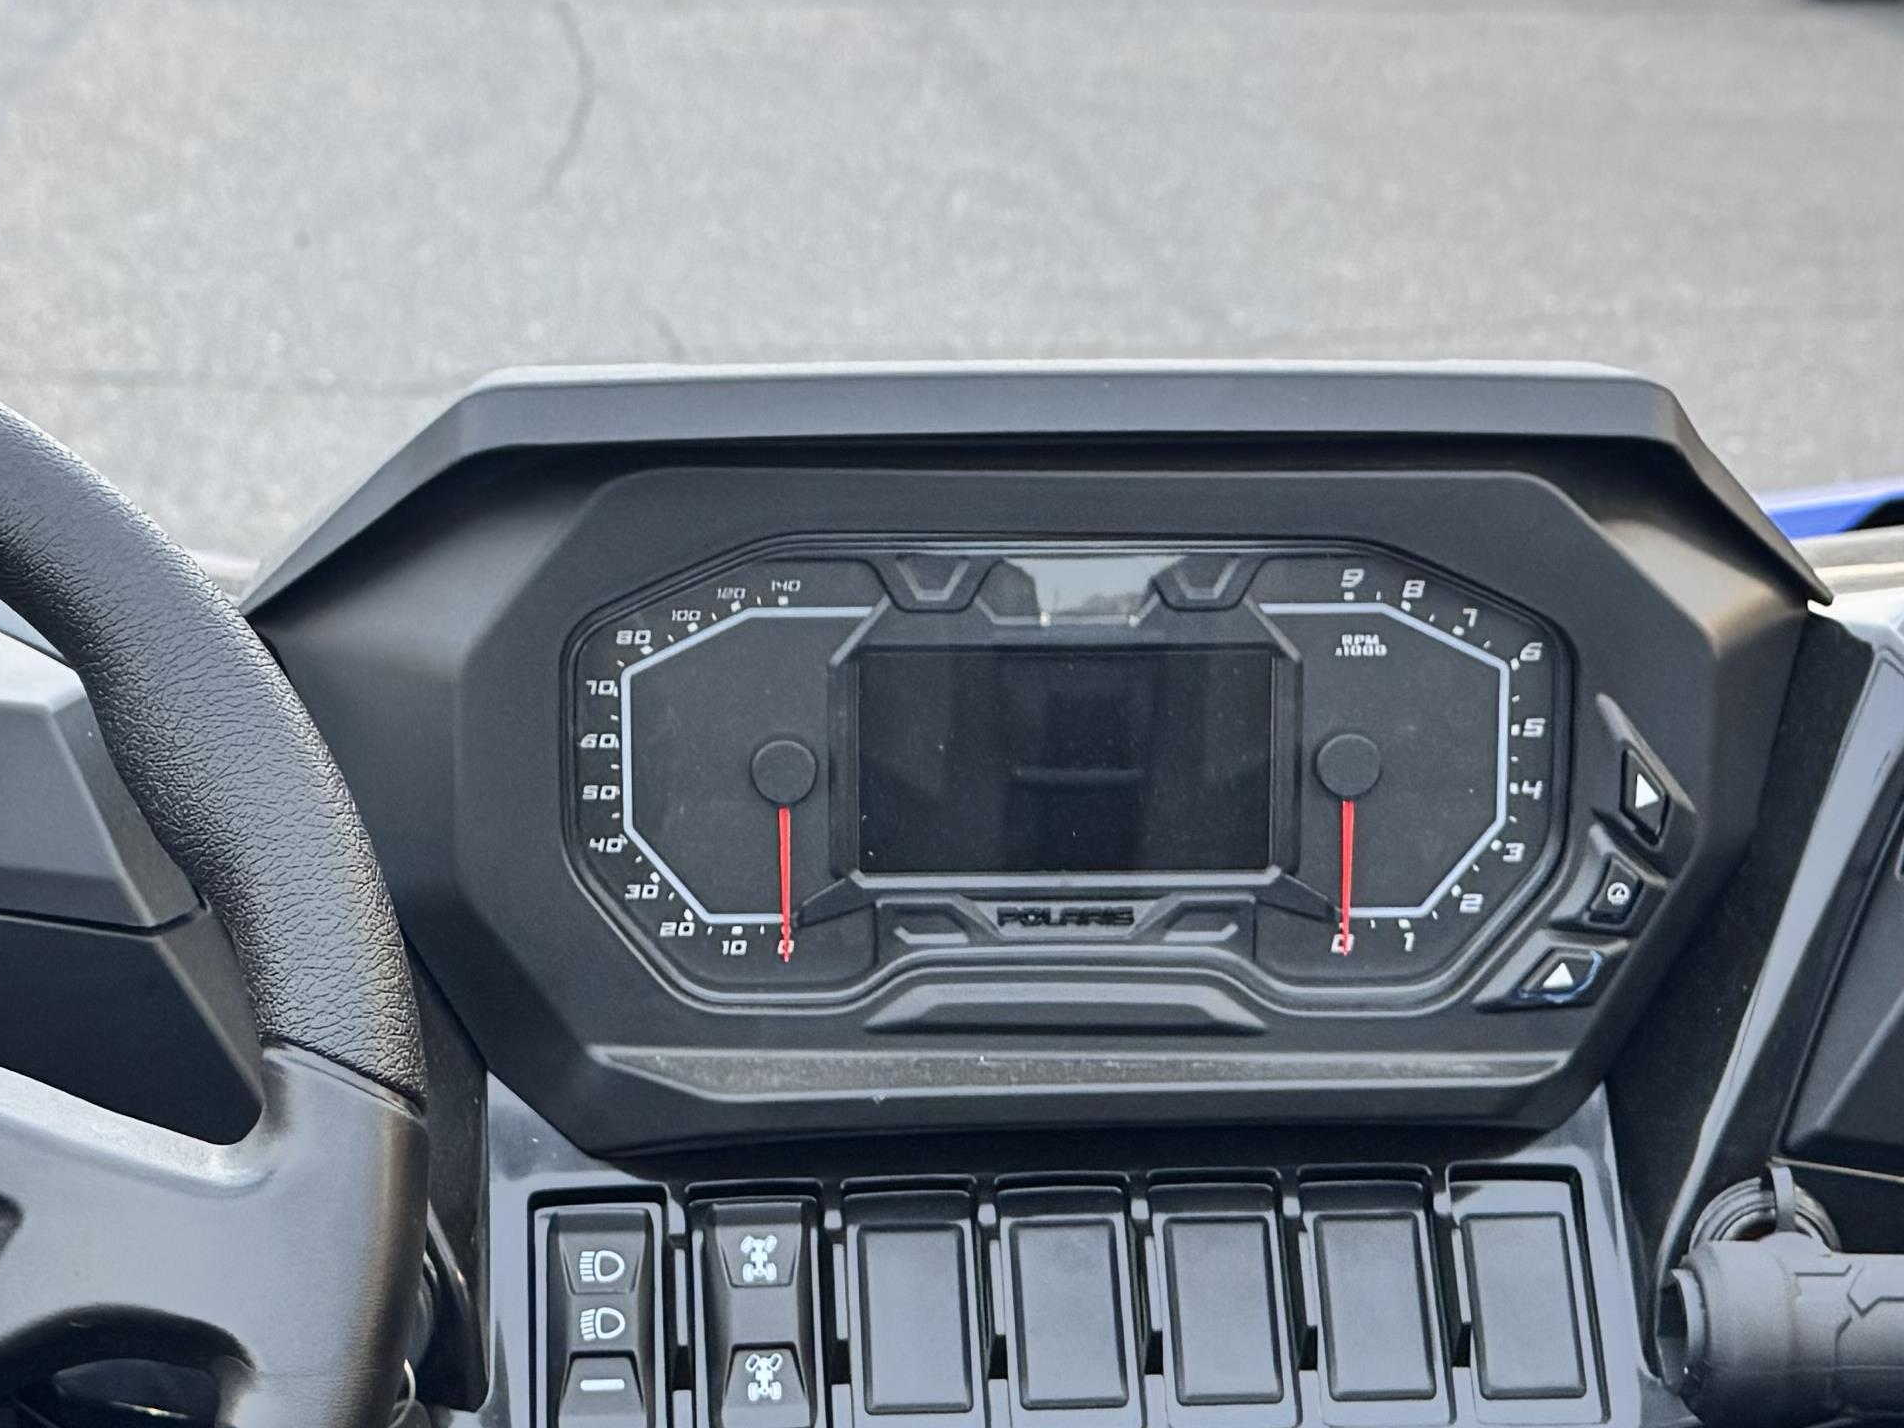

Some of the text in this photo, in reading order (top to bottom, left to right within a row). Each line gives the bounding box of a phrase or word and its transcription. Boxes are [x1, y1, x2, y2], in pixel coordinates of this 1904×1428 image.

[771, 580, 800, 592] 140
[1341, 568, 1365, 588] 9
[717, 587, 746, 600] 120
[1402, 579, 1426, 599] 8
[671, 609, 701, 622] 100
[1462, 607, 1478, 628] 7
[616, 630, 651, 645] 80
[1341, 633, 1381, 646] RPM
[1519, 641, 1544, 662] 6
[585, 679, 616, 696] 70
[1522, 717, 1546, 738] 5
[579, 733, 617, 749] 60
[582, 784, 617, 800] 50
[1521, 779, 1543, 801] 4
[589, 837, 624, 853] 40
[1502, 842, 1526, 863] 3
[624, 883, 659, 900] 30
[1459, 893, 1485, 913] 2
[997, 906, 1135, 928] POLARIS
[659, 921, 696, 937] 20
[721, 939, 748, 956] 10
[777, 939, 795, 955] 0
[1331, 932, 1356, 954] 0
[1404, 931, 1416, 952] 1
